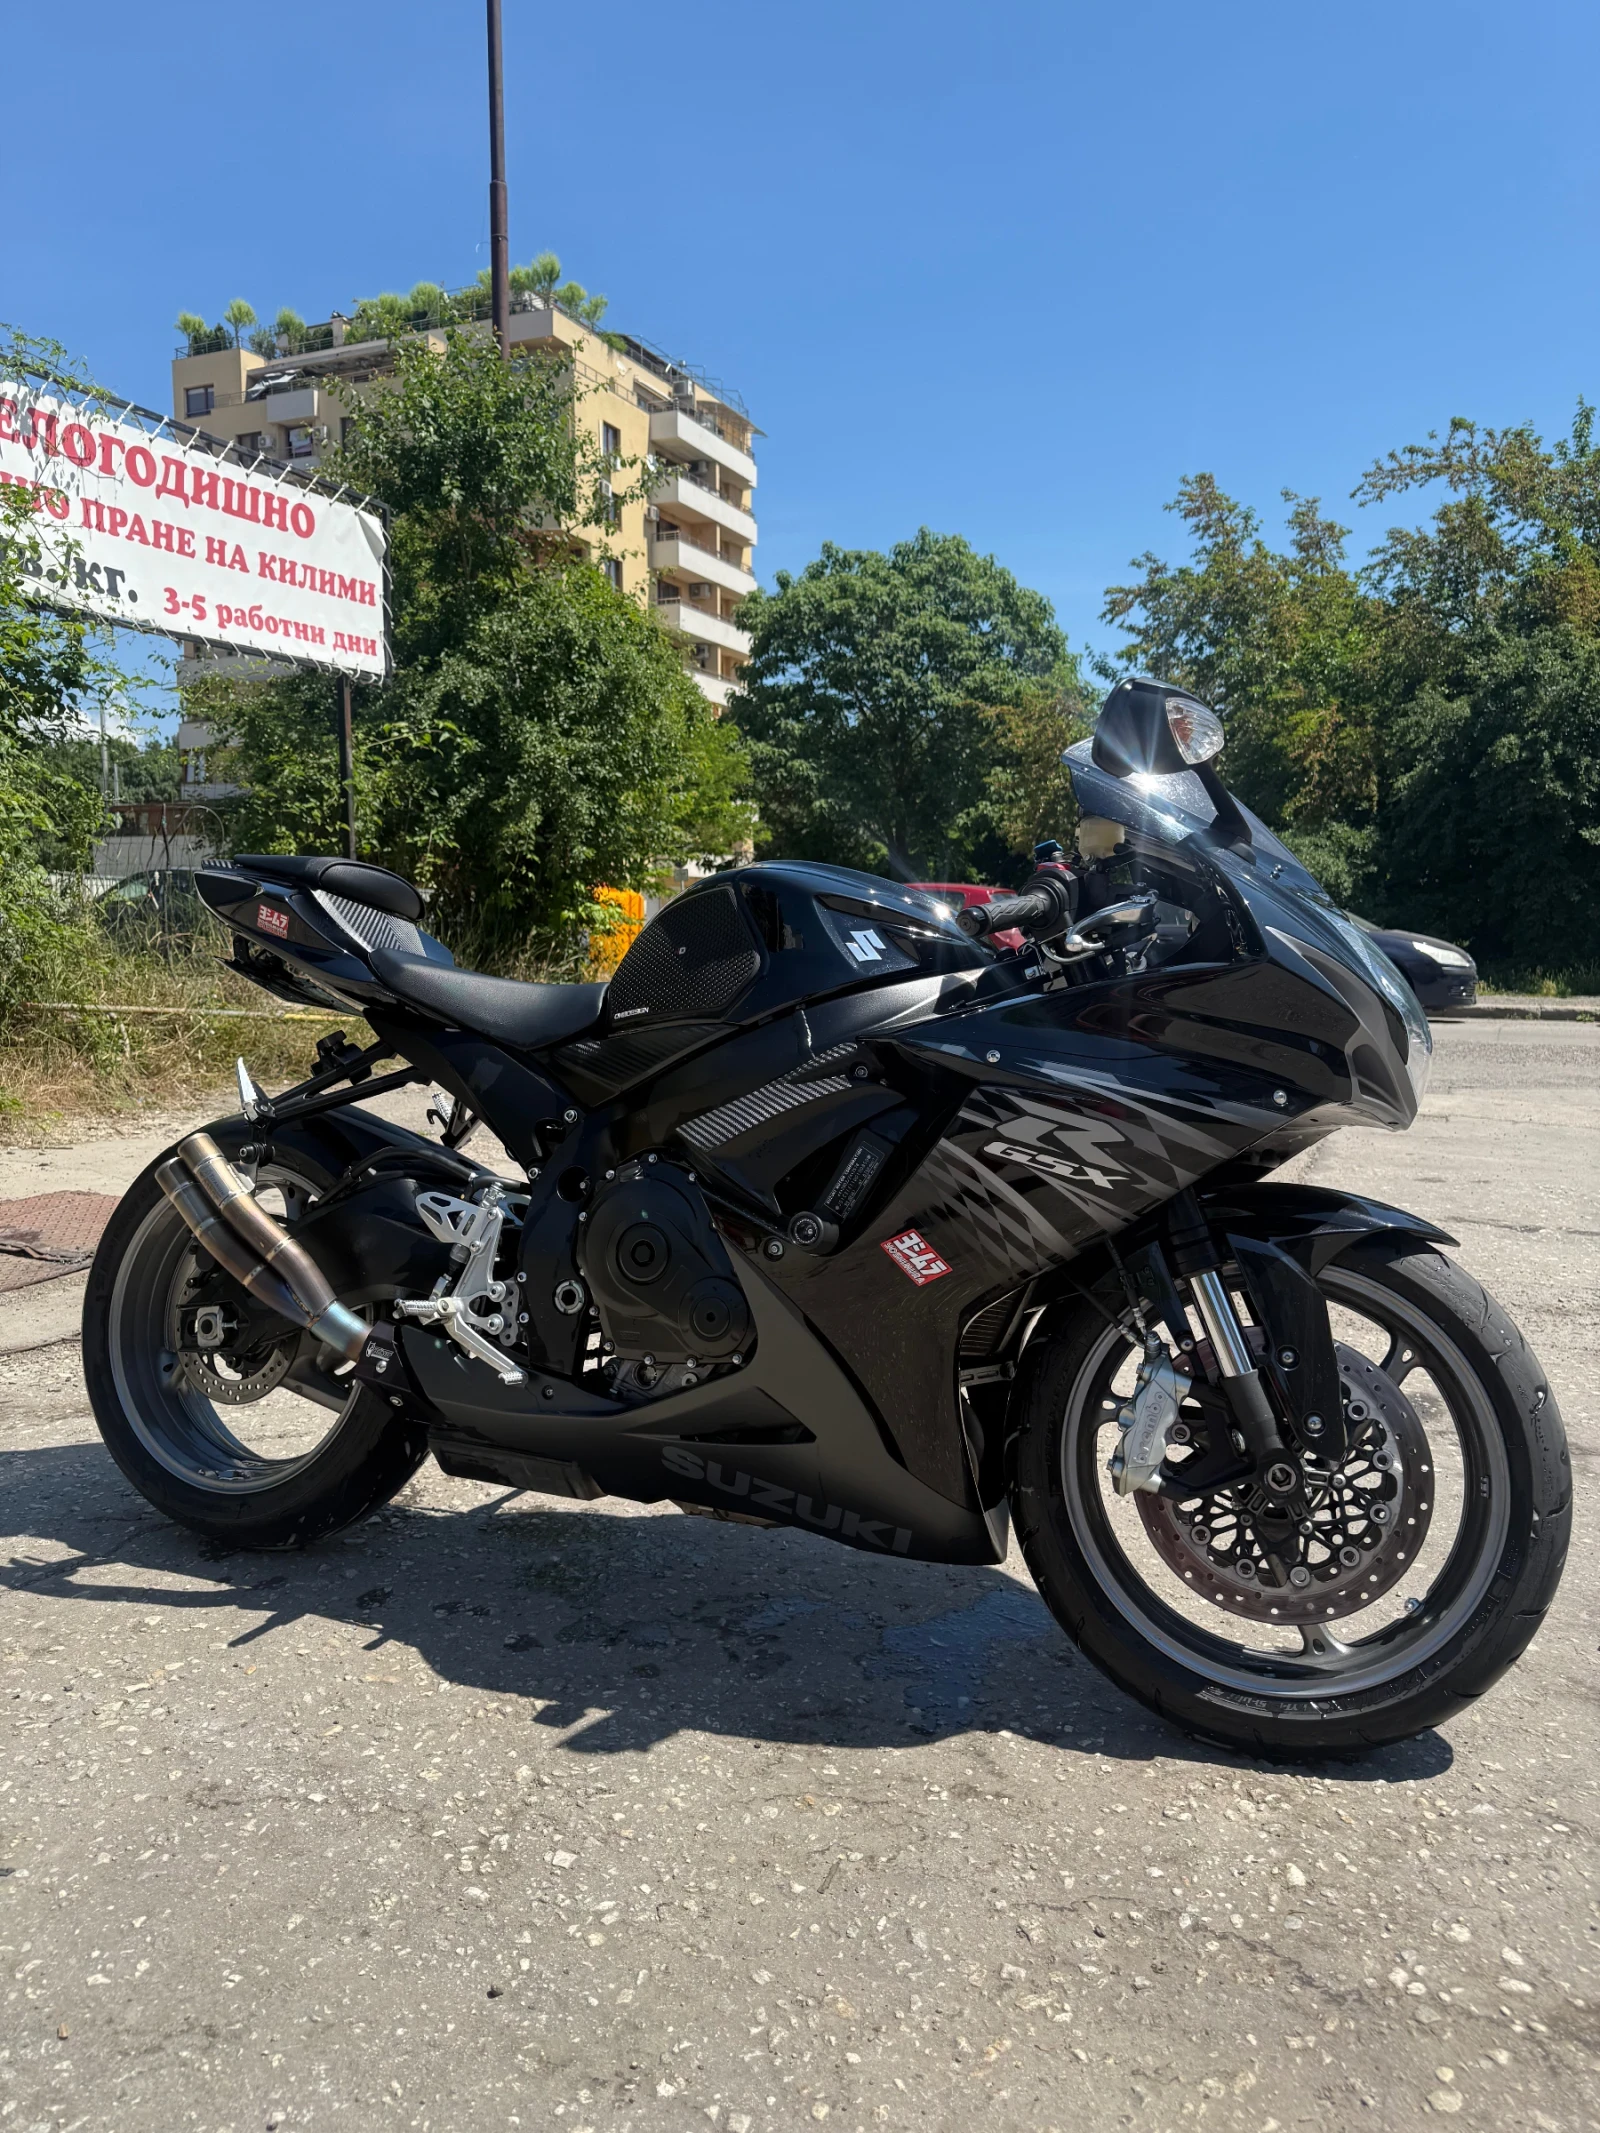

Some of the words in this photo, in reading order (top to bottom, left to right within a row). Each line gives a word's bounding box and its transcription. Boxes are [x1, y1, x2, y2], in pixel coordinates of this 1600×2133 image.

[80, 497, 196, 559] ПРАНЕ
[205, 535, 250, 573] НА
[258, 551, 377, 607] КИЛИМИ
[163, 587, 207, 621] 3-5
[215, 603, 325, 646] работни
[332, 631, 377, 657] дни
[259, 905, 287, 928] ヨシムラ
[983, 1141, 1130, 1190] GSX
[893, 1231, 947, 1274] ヨシムラ
[1134, 1391, 1166, 1464] brembo
[661, 1445, 912, 1554] SUZUKI
